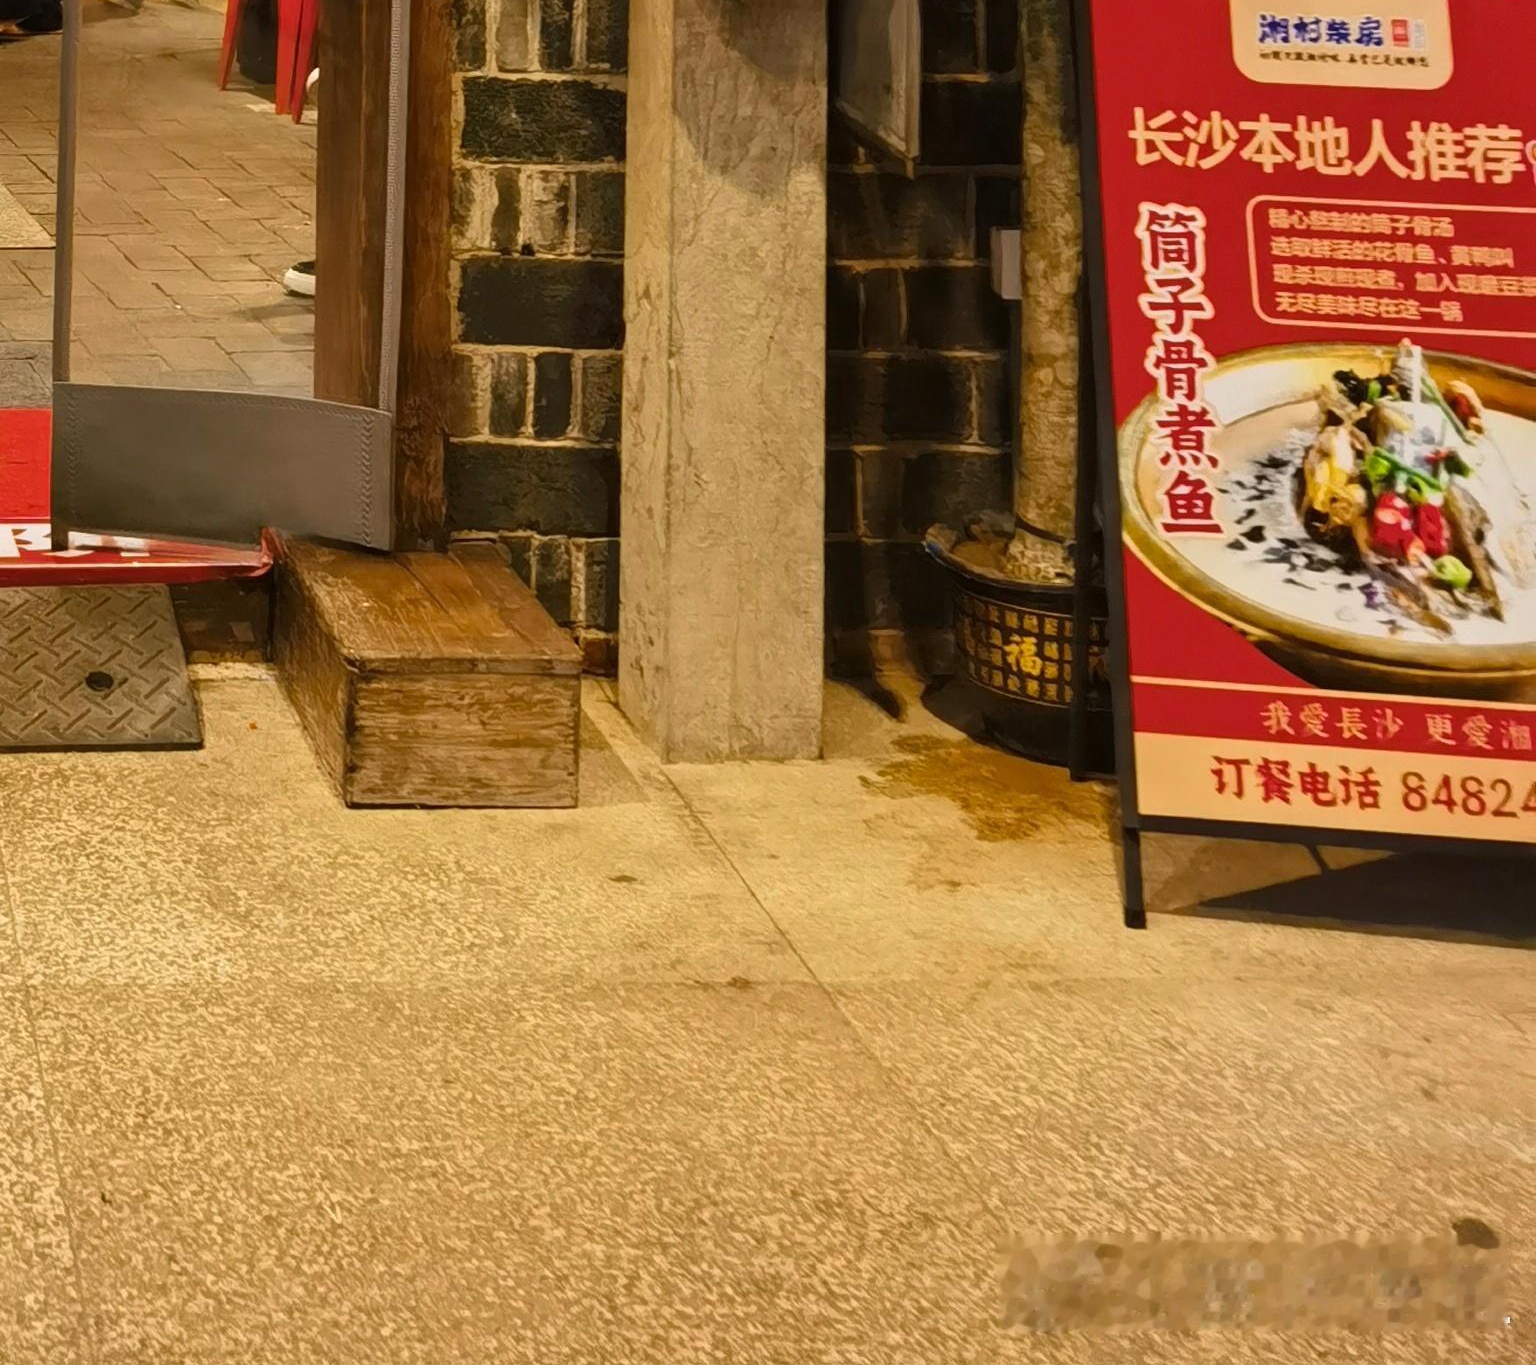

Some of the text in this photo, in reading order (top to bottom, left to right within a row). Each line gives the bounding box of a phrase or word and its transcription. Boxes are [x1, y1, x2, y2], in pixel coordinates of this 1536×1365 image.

[1258, 14, 1385, 47] 湘村柴房
[1128, 106, 1527, 184] 长沙本地人推荐
[1144, 207, 1225, 536] 筒子骨煮鱼
[1260, 699, 1405, 740] 我愛長沙
[1210, 754, 1383, 812] 订餐电话
